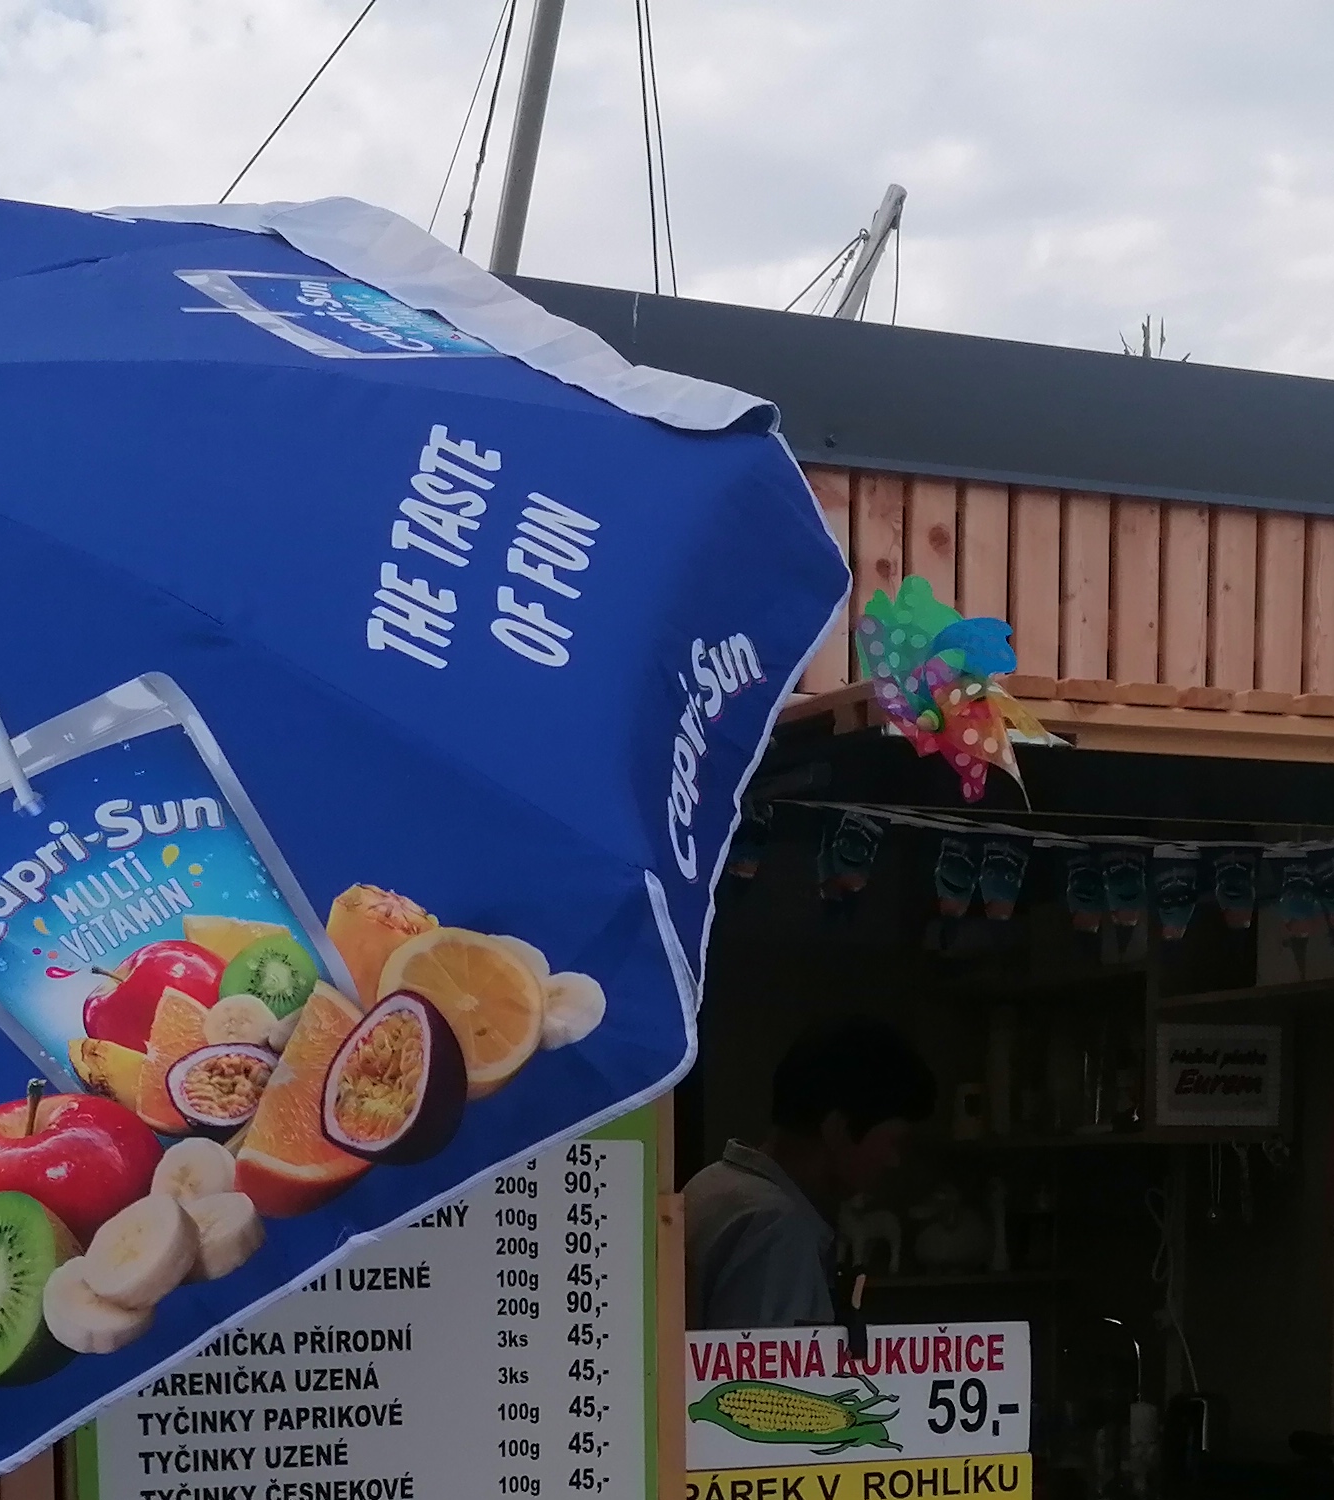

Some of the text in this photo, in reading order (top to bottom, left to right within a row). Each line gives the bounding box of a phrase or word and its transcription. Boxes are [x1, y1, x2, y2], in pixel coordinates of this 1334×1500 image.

[391, 424, 501, 567] TASTE
[490, 493, 600, 667] OF FUN
[367, 562, 457, 669] THE
[667, 632, 766, 882] Capri-Sun
[567, 1145, 607, 1169] 45,-
[495, 1171, 607, 1198] 200g 90,-
[495, 1209, 537, 1230] 100g
[567, 1204, 608, 1229] 45,-
[496, 1232, 607, 1258] 200g 90,-
[349, 1262, 431, 1291] UZENÉ
[496, 1270, 539, 1291] 100g
[567, 1263, 608, 1289] 45,-
[497, 1292, 608, 1319] 200g 90,-
[294, 1323, 412, 1355] PŘÍRODNÍ
[497, 1330, 529, 1348] 3ks
[568, 1324, 609, 1349] 45,-
[690, 1326, 1005, 1381] VAŘENÁ KUKUŘICE
[295, 1362, 379, 1392] UZENÁ
[498, 1366, 529, 1385] 3ks
[569, 1360, 609, 1386] 45,-
[138, 1397, 609, 1436] TYČINKY PAPRIKOVÉ 100g 45,-
[928, 1378, 1019, 1436] 59,-
[139, 1433, 609, 1474] TYČINKY UZENÉ 100g 45,-
[498, 1476, 541, 1497] 100g
[569, 1469, 609, 1494] 45,-
[864, 1459, 1019, 1500] ROHLÍKU
